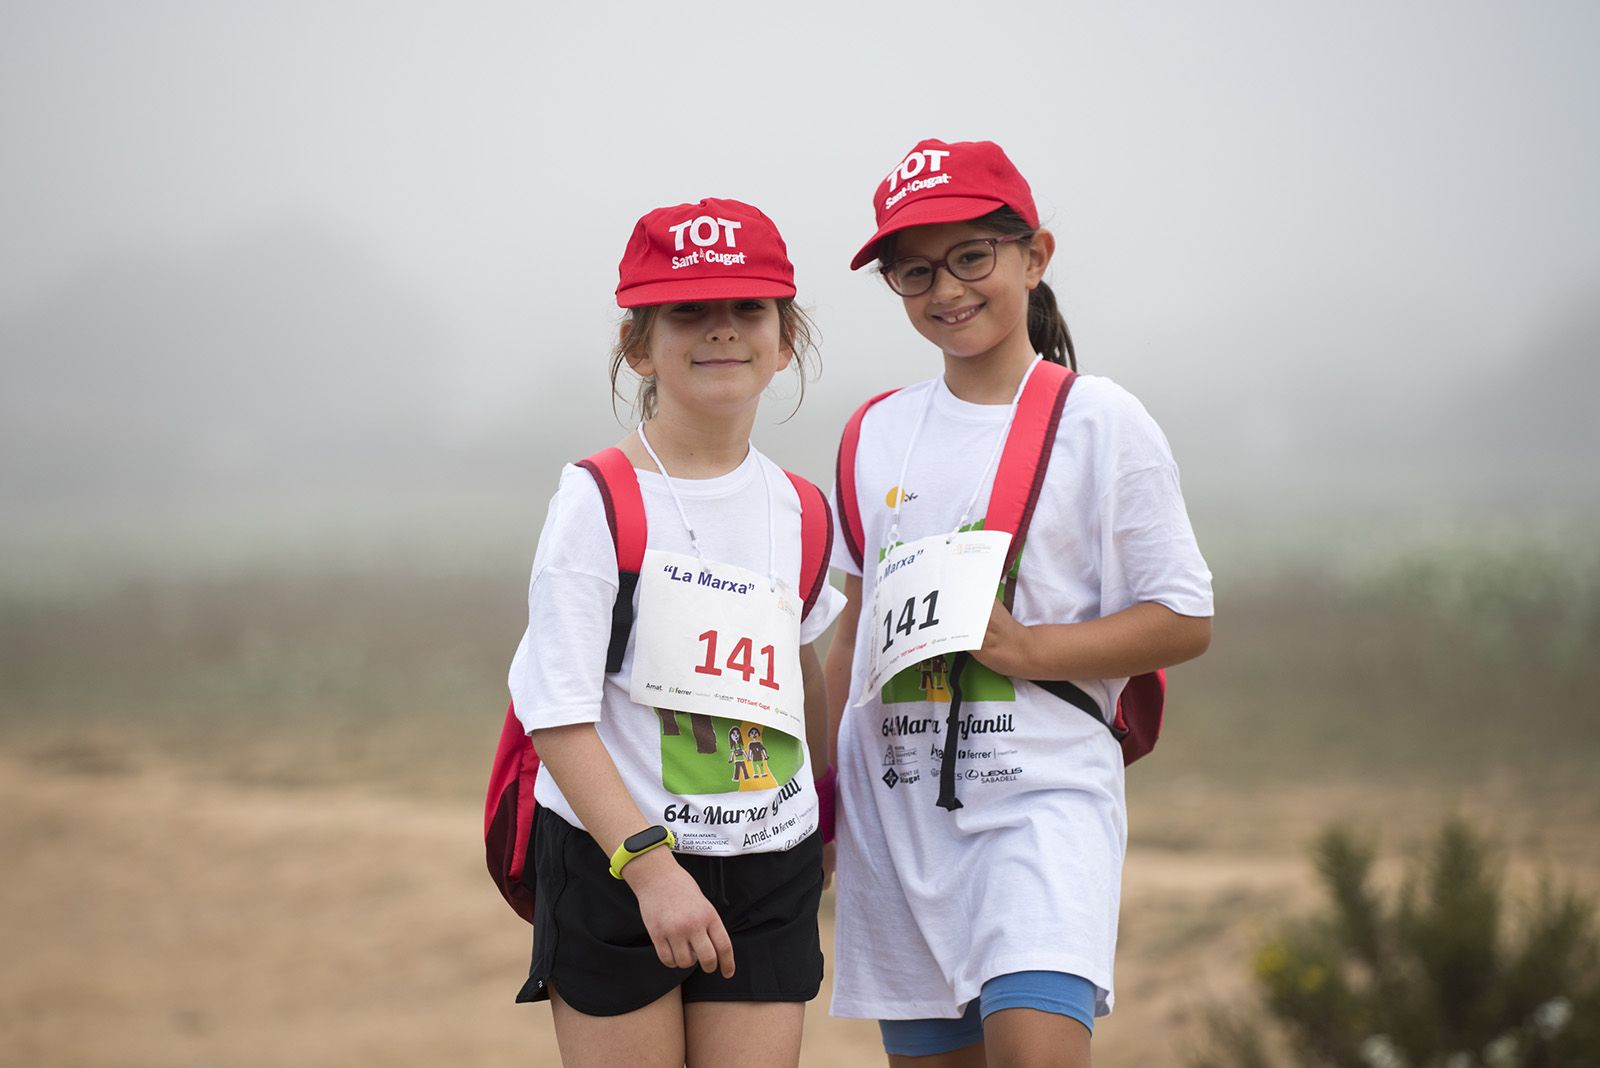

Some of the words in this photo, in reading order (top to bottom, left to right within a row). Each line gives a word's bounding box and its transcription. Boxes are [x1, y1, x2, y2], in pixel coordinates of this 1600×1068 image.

[886, 149, 950, 192] TOT
[911, 173, 950, 192] Cugat
[668, 215, 742, 251] TOT
[671, 251, 700, 270] Sant
[705, 249, 746, 266] Cugat
[882, 589, 940, 654] 141
[694, 629, 780, 691] 141
[736, 697, 748, 705] TOT
[967, 749, 992, 760] ferrer
[980, 766, 1023, 778] LEXUS
[981, 775, 1017, 784] SABADELL
[703, 806, 769, 825] Marxa
